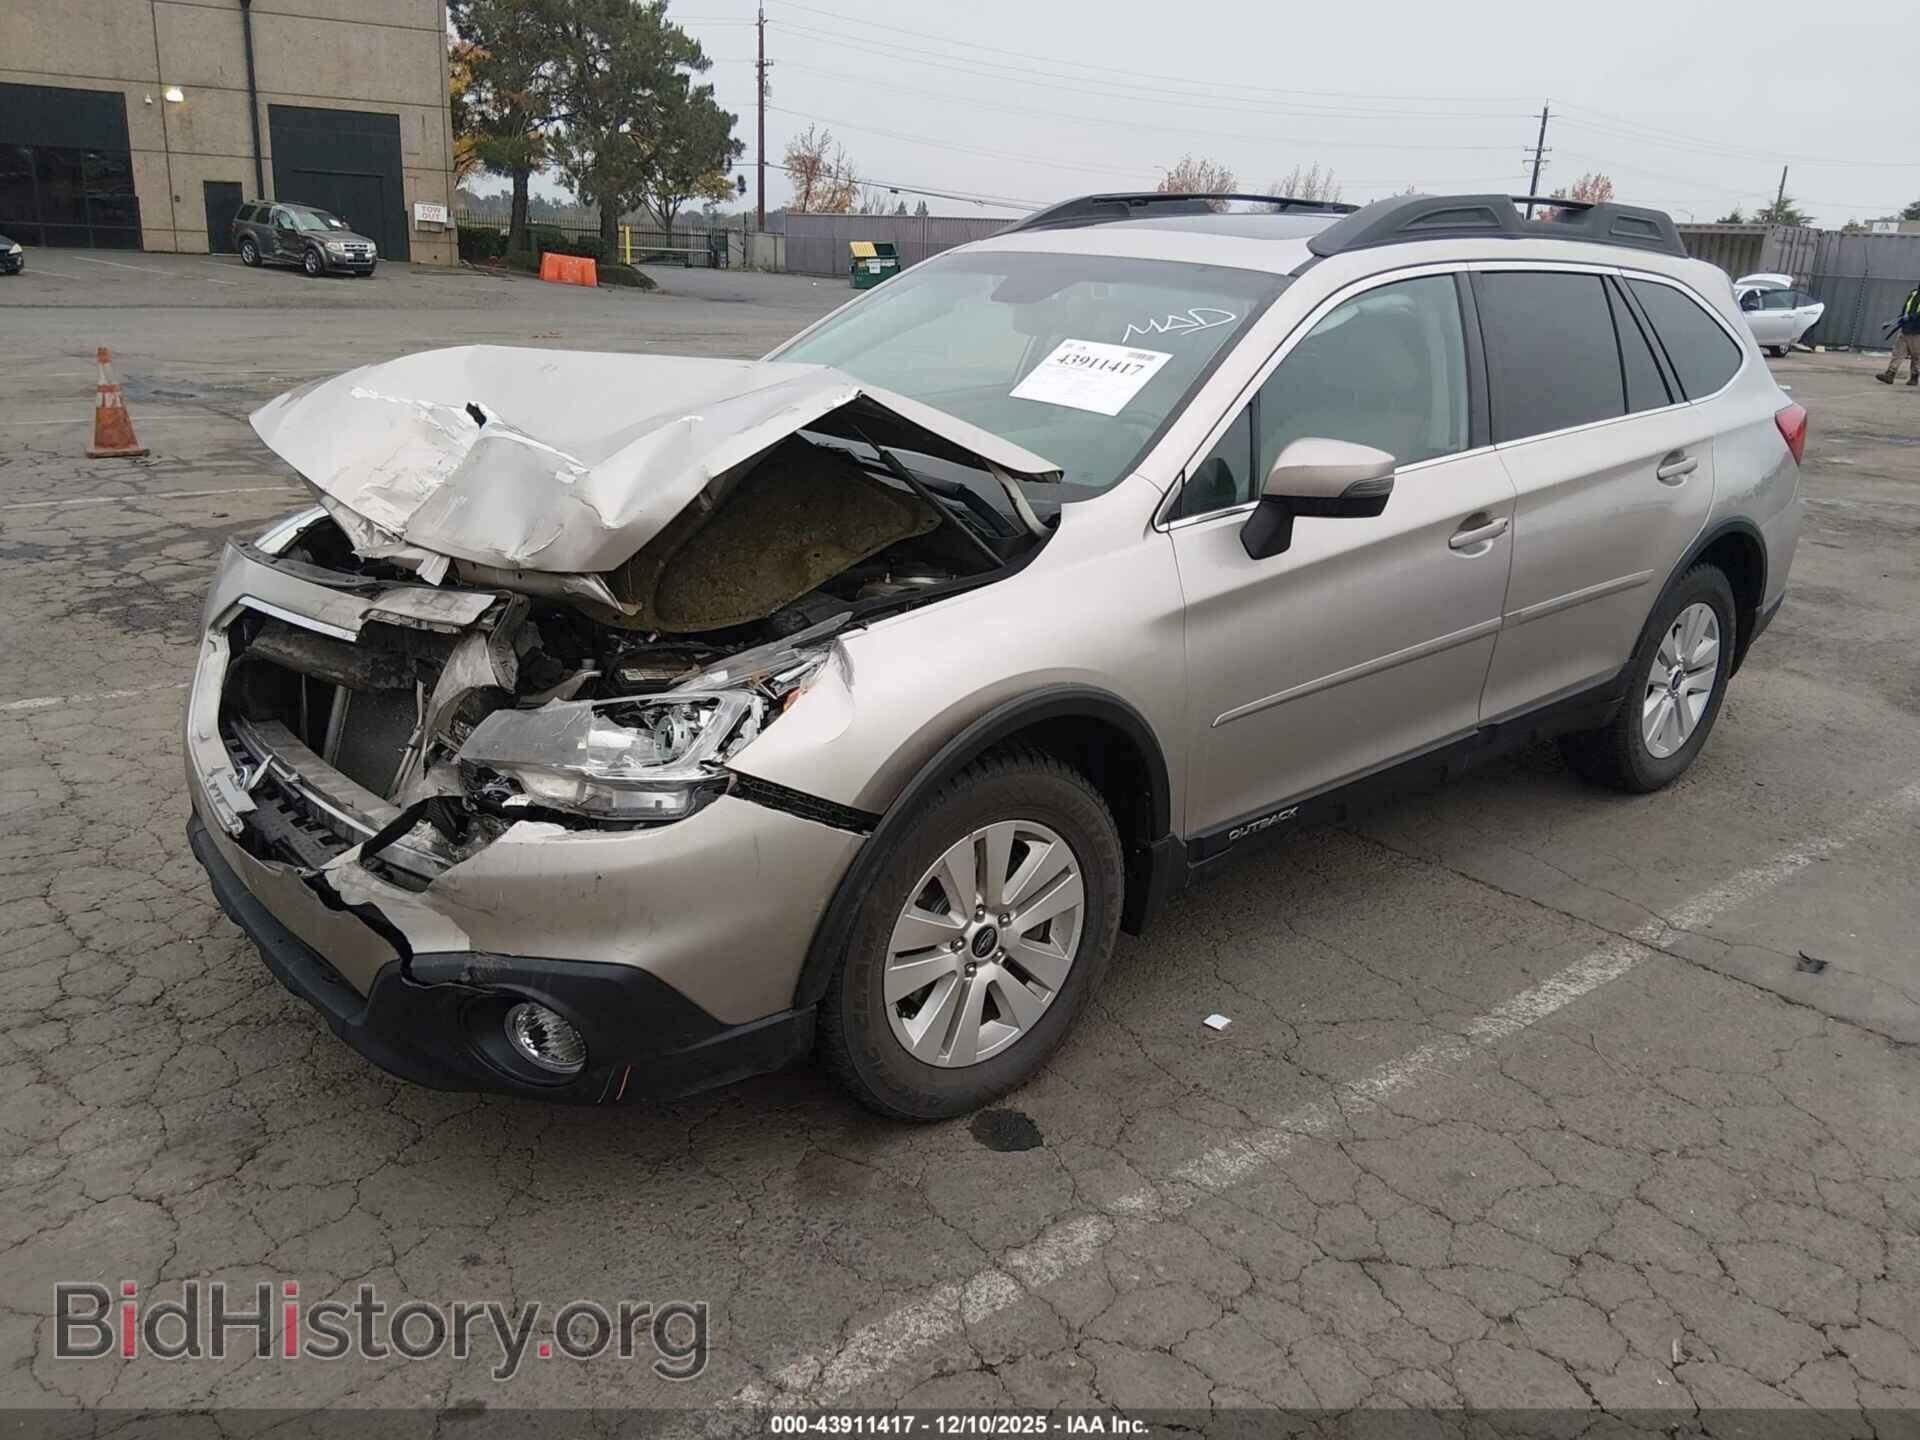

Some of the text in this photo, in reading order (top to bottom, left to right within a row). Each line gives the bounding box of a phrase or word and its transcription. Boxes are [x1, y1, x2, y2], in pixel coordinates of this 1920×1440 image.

[421, 206, 441, 214] TOW
[422, 213, 441, 221] OUT
[1122, 307, 1237, 343] MAD
[1056, 353, 1145, 376] 43911417
[1228, 806, 1299, 841] OUTBACK
